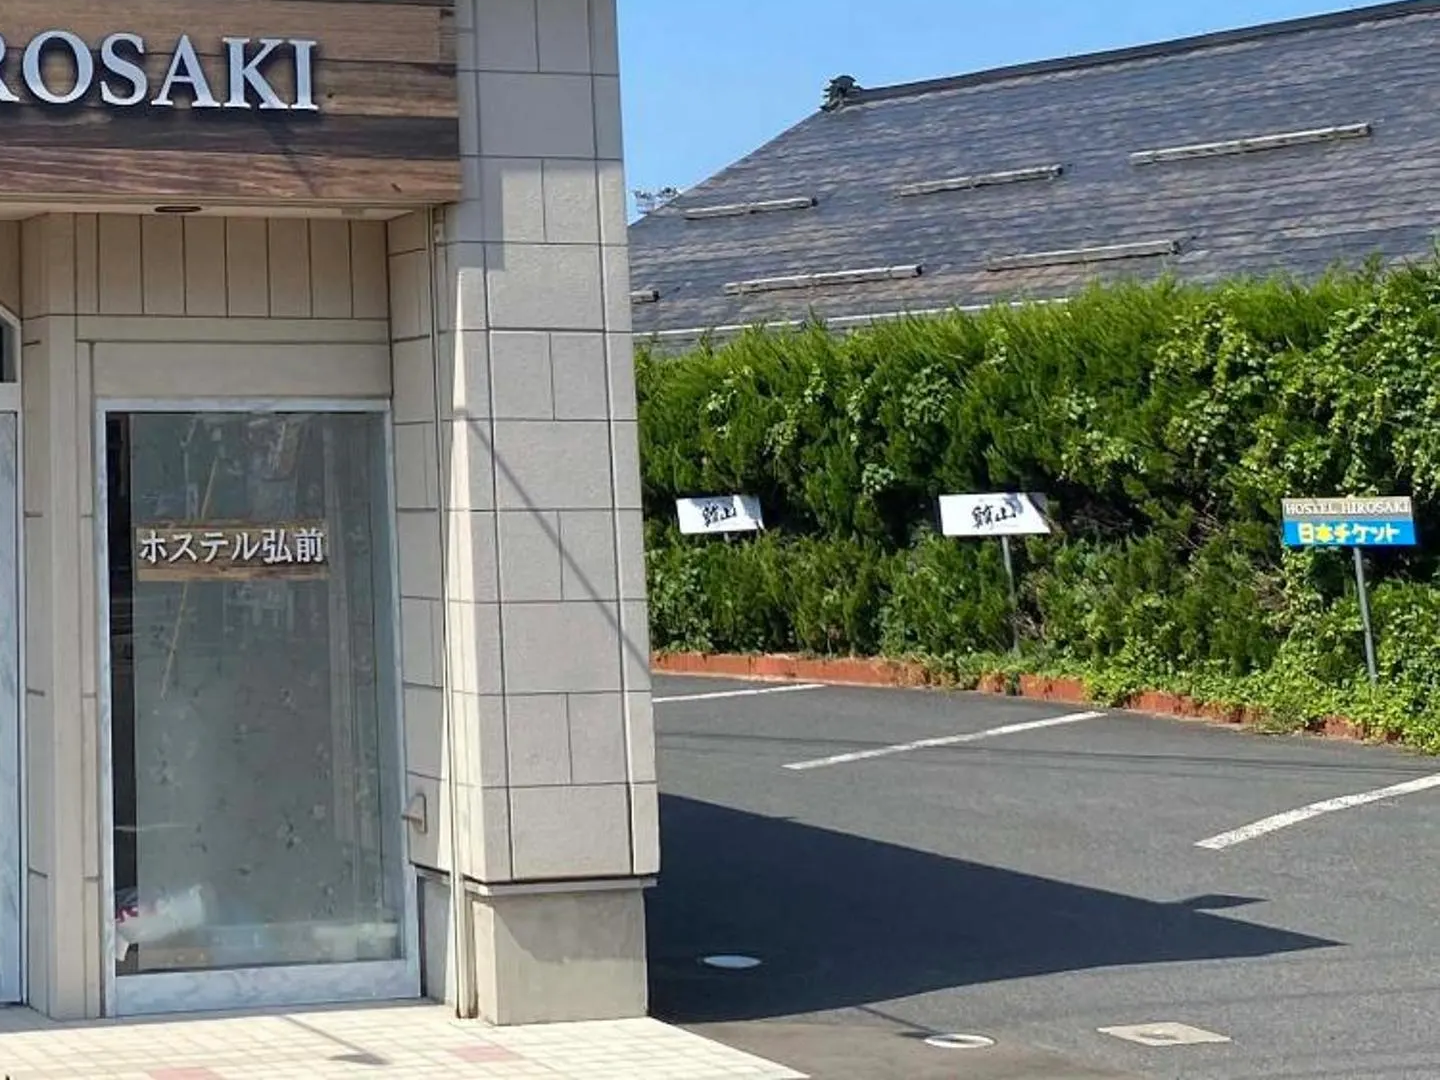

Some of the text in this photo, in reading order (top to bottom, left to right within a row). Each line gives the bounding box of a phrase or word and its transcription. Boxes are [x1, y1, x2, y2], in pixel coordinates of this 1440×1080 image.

[1285, 501, 1409, 515] HOSTEL HIROSAKI
[137, 528, 327, 565] ホステル弘前
